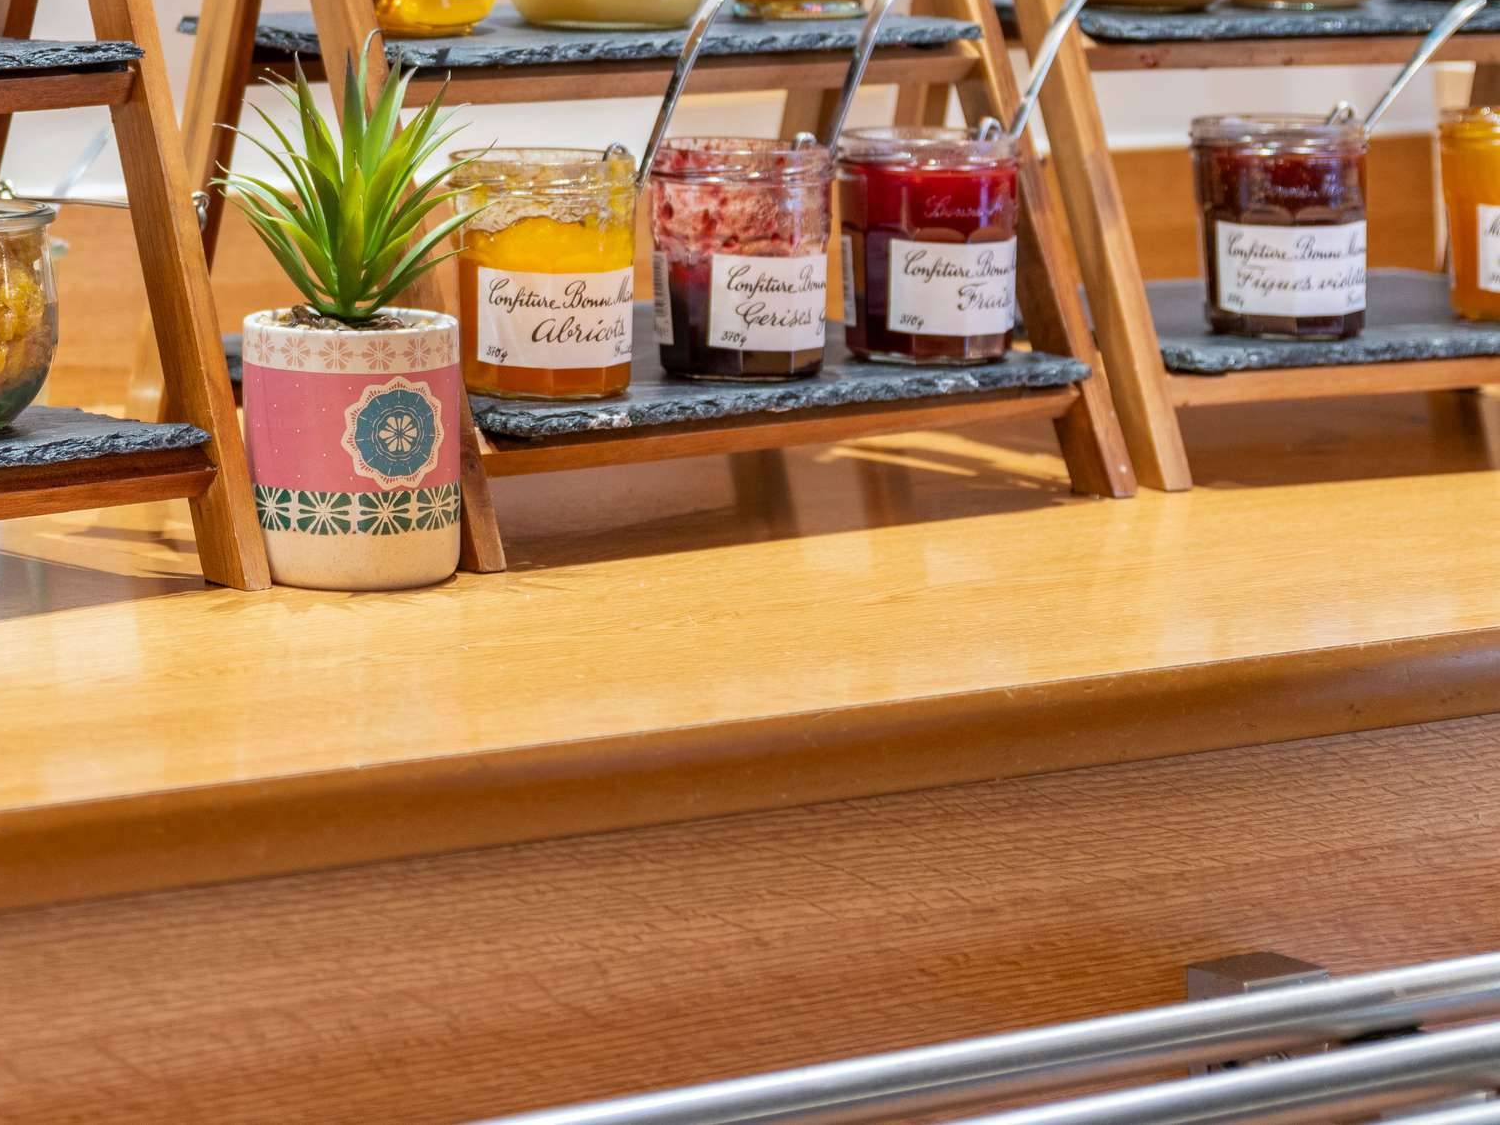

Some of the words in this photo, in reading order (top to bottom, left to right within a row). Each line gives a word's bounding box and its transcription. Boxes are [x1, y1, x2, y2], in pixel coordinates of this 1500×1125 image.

[1227, 231, 1291, 266] Confiture
[1292, 233, 1343, 261] Bonne
[726, 264, 797, 299] Confiture
[903, 249, 973, 283] Confiture
[488, 277, 560, 314] Confiture
[562, 280, 612, 310] Bonne
[531, 315, 626, 343] Abricots
[734, 301, 813, 329] Cerises
